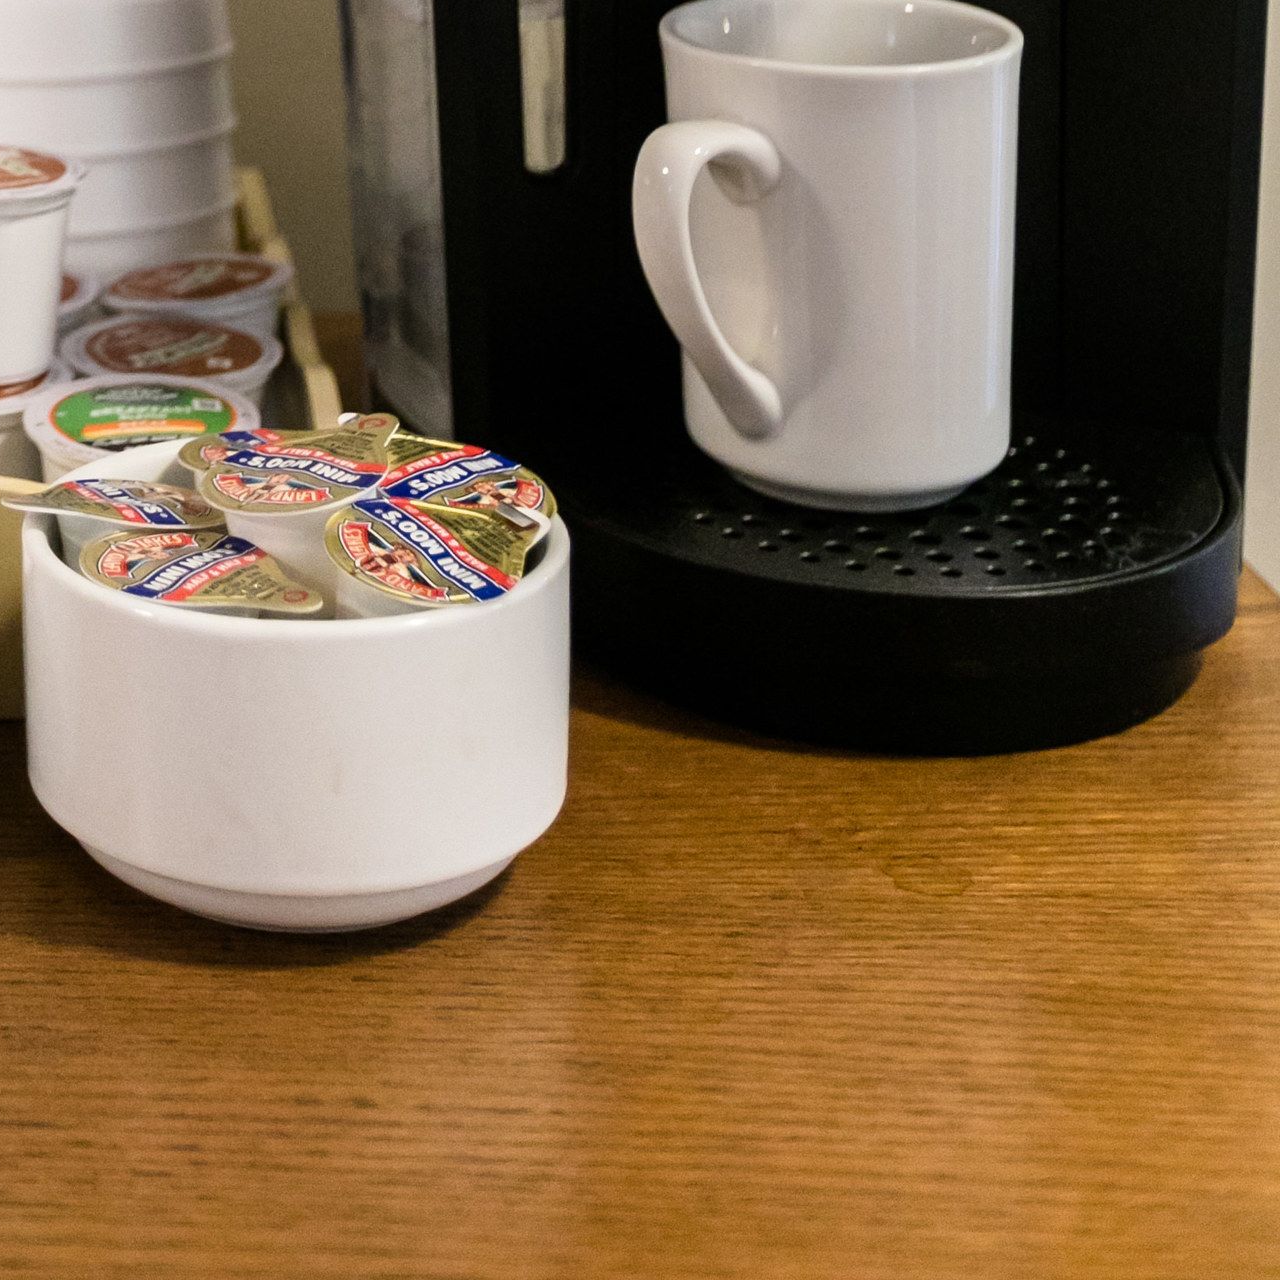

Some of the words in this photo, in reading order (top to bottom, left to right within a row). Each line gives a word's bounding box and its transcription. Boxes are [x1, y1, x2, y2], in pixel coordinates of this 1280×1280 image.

[246, 456, 313, 469] MOO'S
[309, 462, 360, 484] MINI
[407, 465, 468, 492] MOO'S
[381, 510, 444, 555] MOO'S
[417, 515, 449, 537] HALF
[139, 534, 183, 548] LAKES
[143, 566, 188, 591] MINI
[180, 548, 236, 569] MOO'S
[456, 547, 488, 570] HALF
[183, 572, 209, 591] HALF
[219, 558, 242, 572] HALF
[437, 557, 487, 590] MINI
